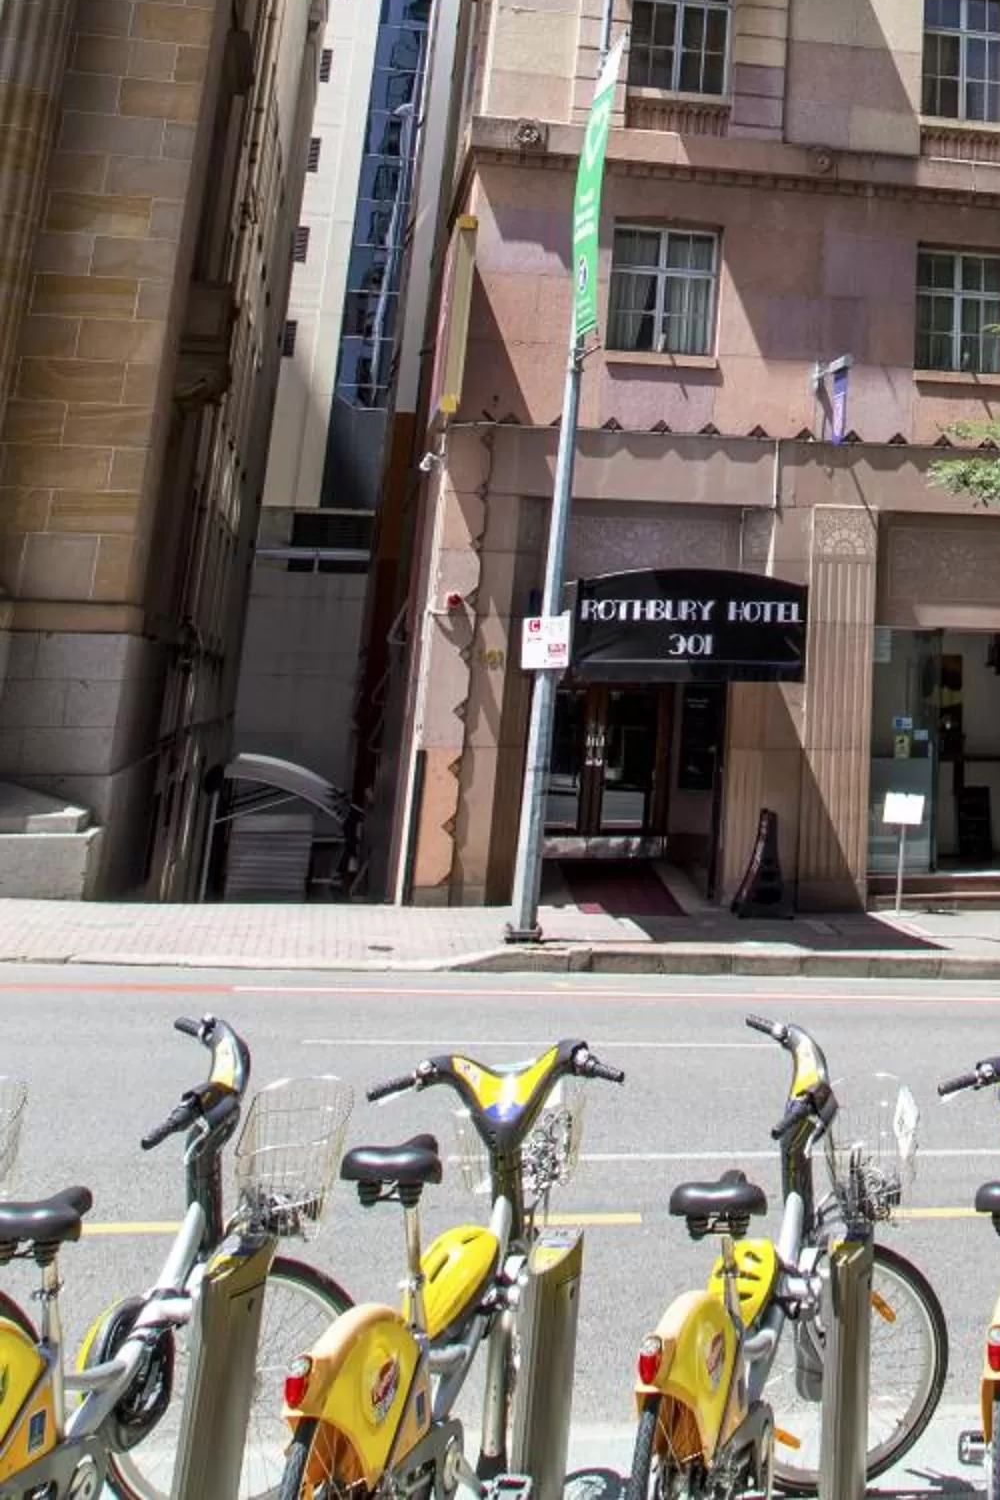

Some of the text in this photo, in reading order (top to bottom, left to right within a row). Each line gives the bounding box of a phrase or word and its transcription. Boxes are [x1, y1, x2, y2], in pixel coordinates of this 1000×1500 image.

[581, 599, 804, 623] ROTHBURY HOTEL
[668, 633, 713, 655] 301
